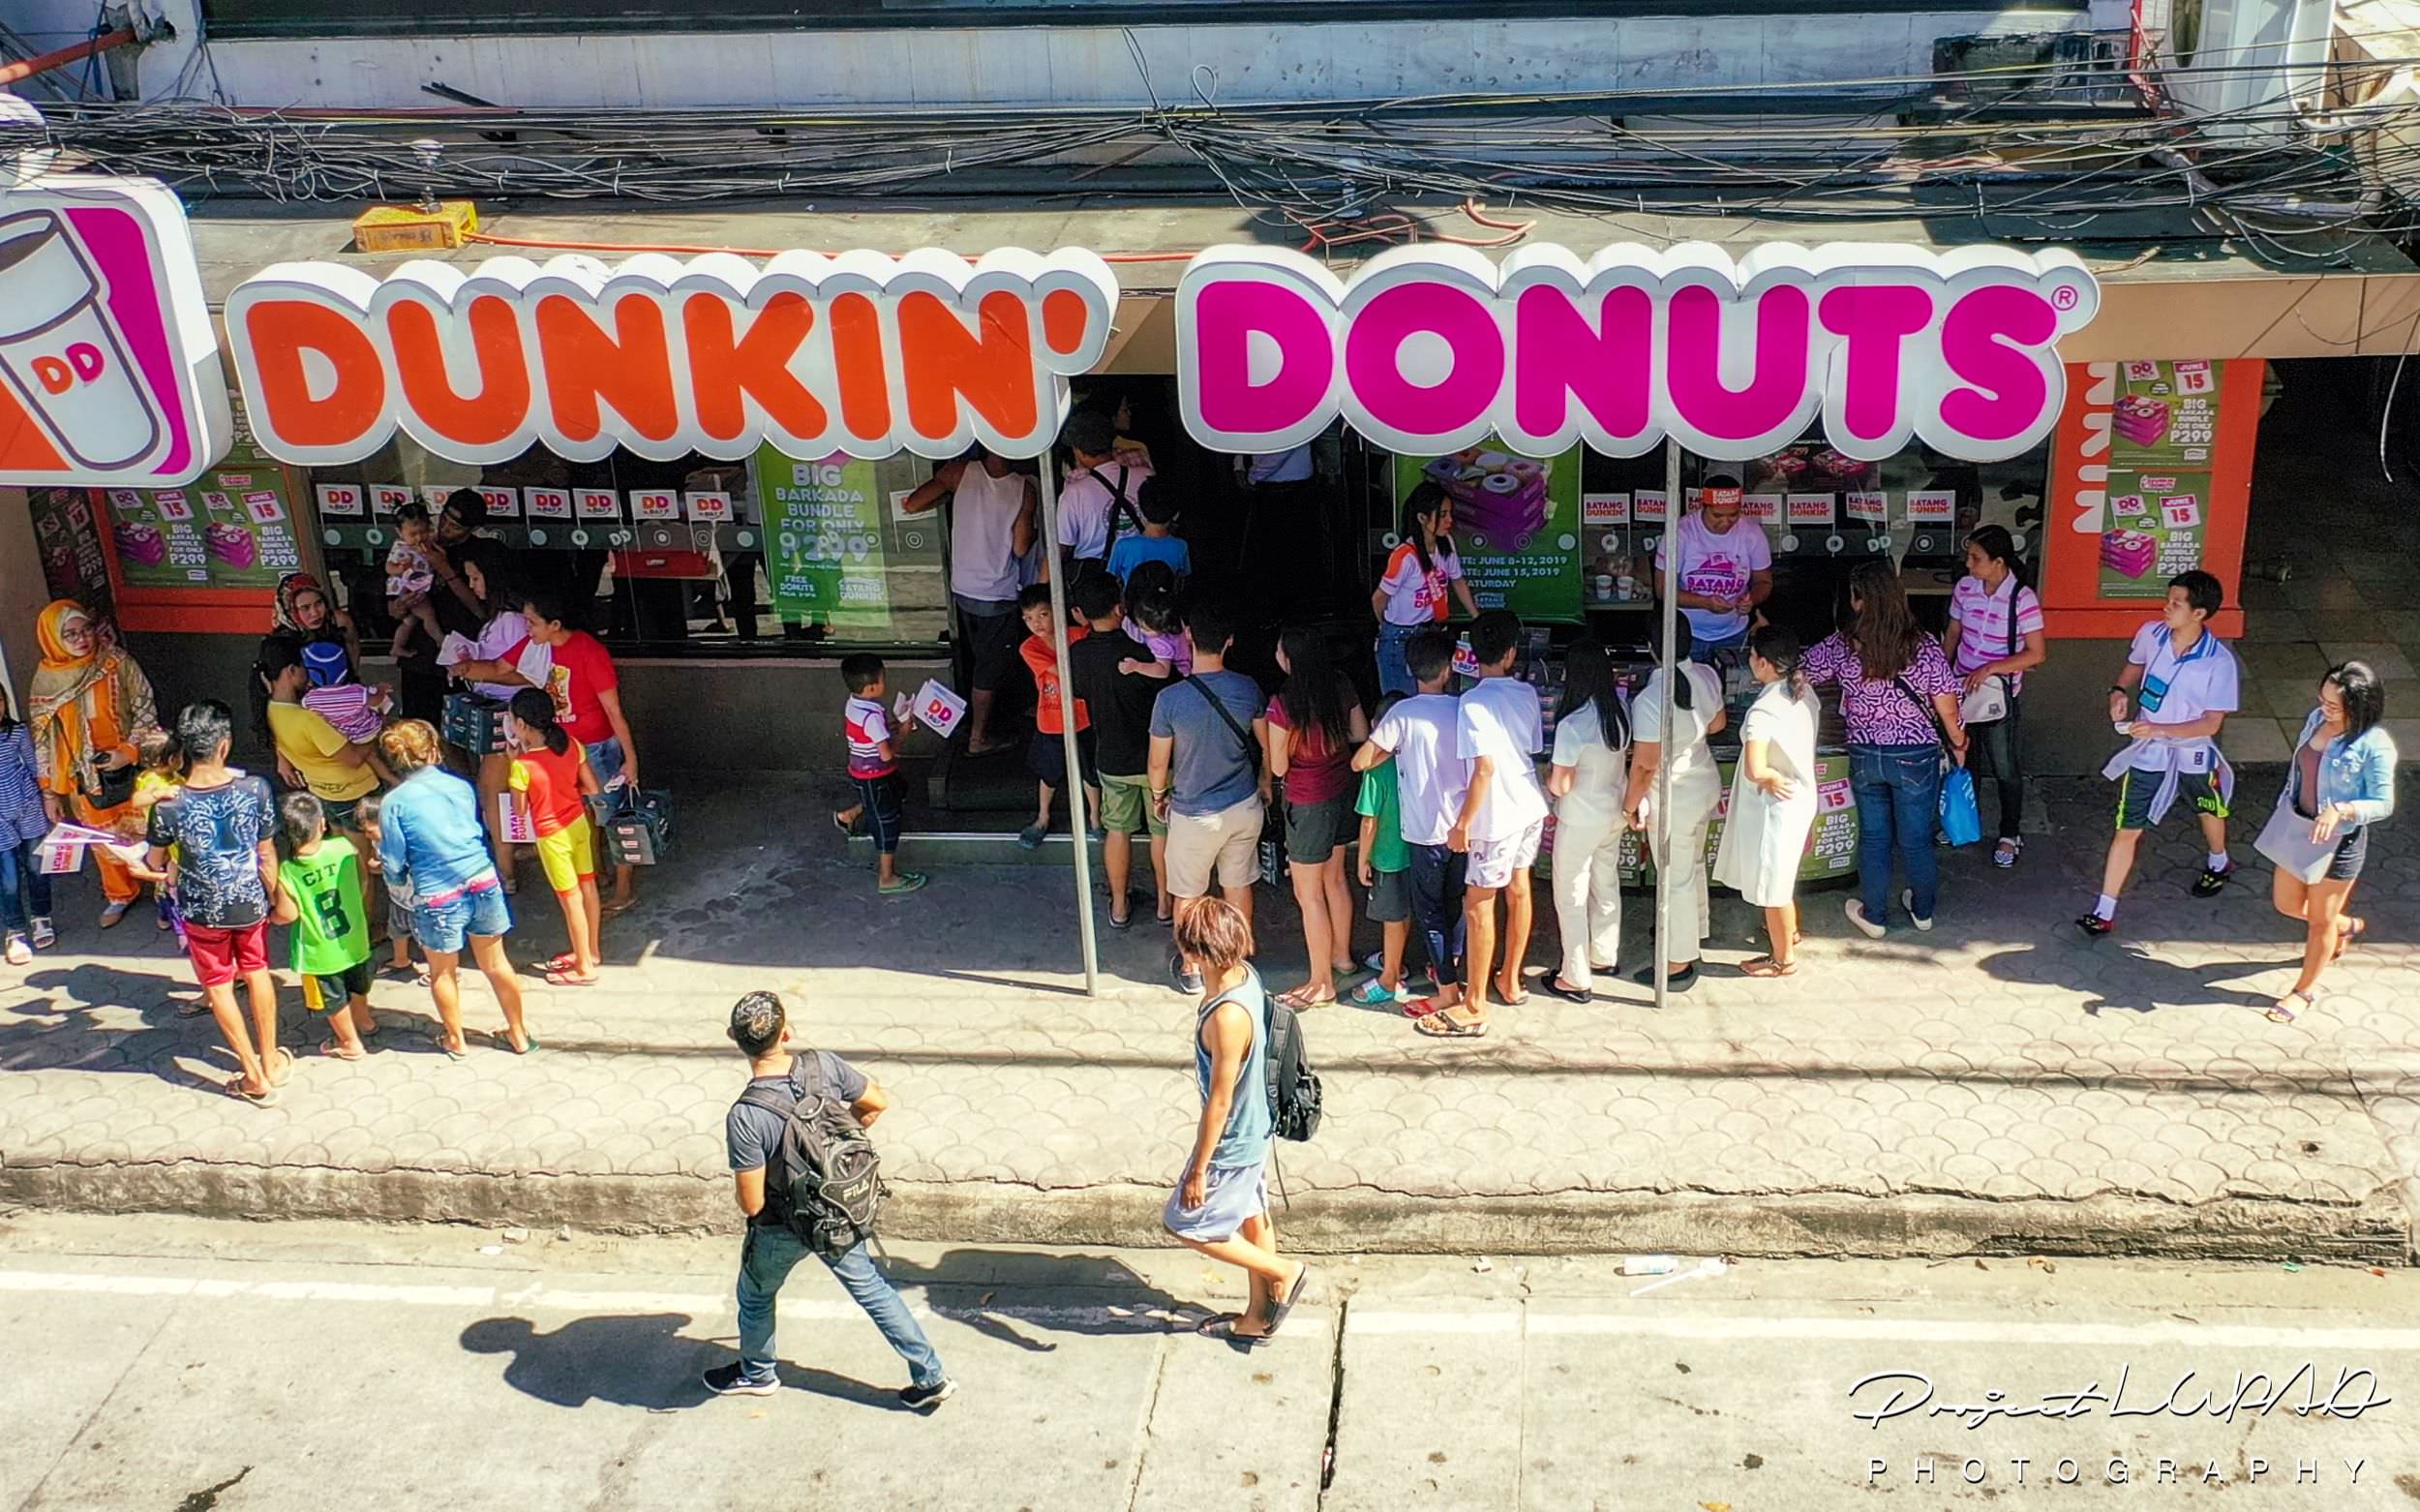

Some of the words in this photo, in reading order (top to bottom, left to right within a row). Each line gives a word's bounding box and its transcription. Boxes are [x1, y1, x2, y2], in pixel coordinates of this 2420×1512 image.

[30, 342, 104, 395] DD
[246, 289, 1087, 445] DUNKIN'
[1196, 281, 2057, 440] DONUTS
[2184, 374, 2204, 389] 15
[2183, 399, 2207, 409] BIG
[2170, 430, 2213, 442] P299
[792, 465, 842, 487] BIG
[327, 491, 353, 504] DD
[484, 493, 509, 505] DD
[535, 494, 561, 506] DD
[774, 487, 863, 502] BARKADA
[585, 495, 611, 507] DD
[642, 496, 668, 508] DD
[697, 498, 722, 510] DD
[1637, 498, 1666, 506] BATAN
[1848, 497, 1883, 506] BATANG
[164, 501, 185, 517] 15
[254, 503, 276, 518] 15
[788, 503, 855, 518] BUNDLE
[2170, 508, 2191, 523] 15
[171, 524, 193, 534] BIG
[261, 526, 284, 535] BIG
[780, 519, 817, 532] FOR
[821, 519, 865, 533] ONLY
[609, 529, 631, 546] DD
[2169, 531, 2193, 542] BIG
[169, 553, 206, 565] P299
[259, 554, 298, 566] P299
[1479, 557, 1505, 565] JUNE
[1540, 557, 1567, 565] 2019
[1532, 567, 1560, 576] 2019
[1467, 579, 1517, 588] ATURDAY
[1687, 577, 1744, 590] BATANG
[928, 698, 953, 722] DD
[1819, 783, 1843, 792] JUNE
[1825, 792, 1845, 807] 15
[1826, 813, 1849, 825] BIG
[1815, 839, 1855, 857] P299
[315, 889, 350, 940] 8
[843, 1179, 869, 1202] FILA
